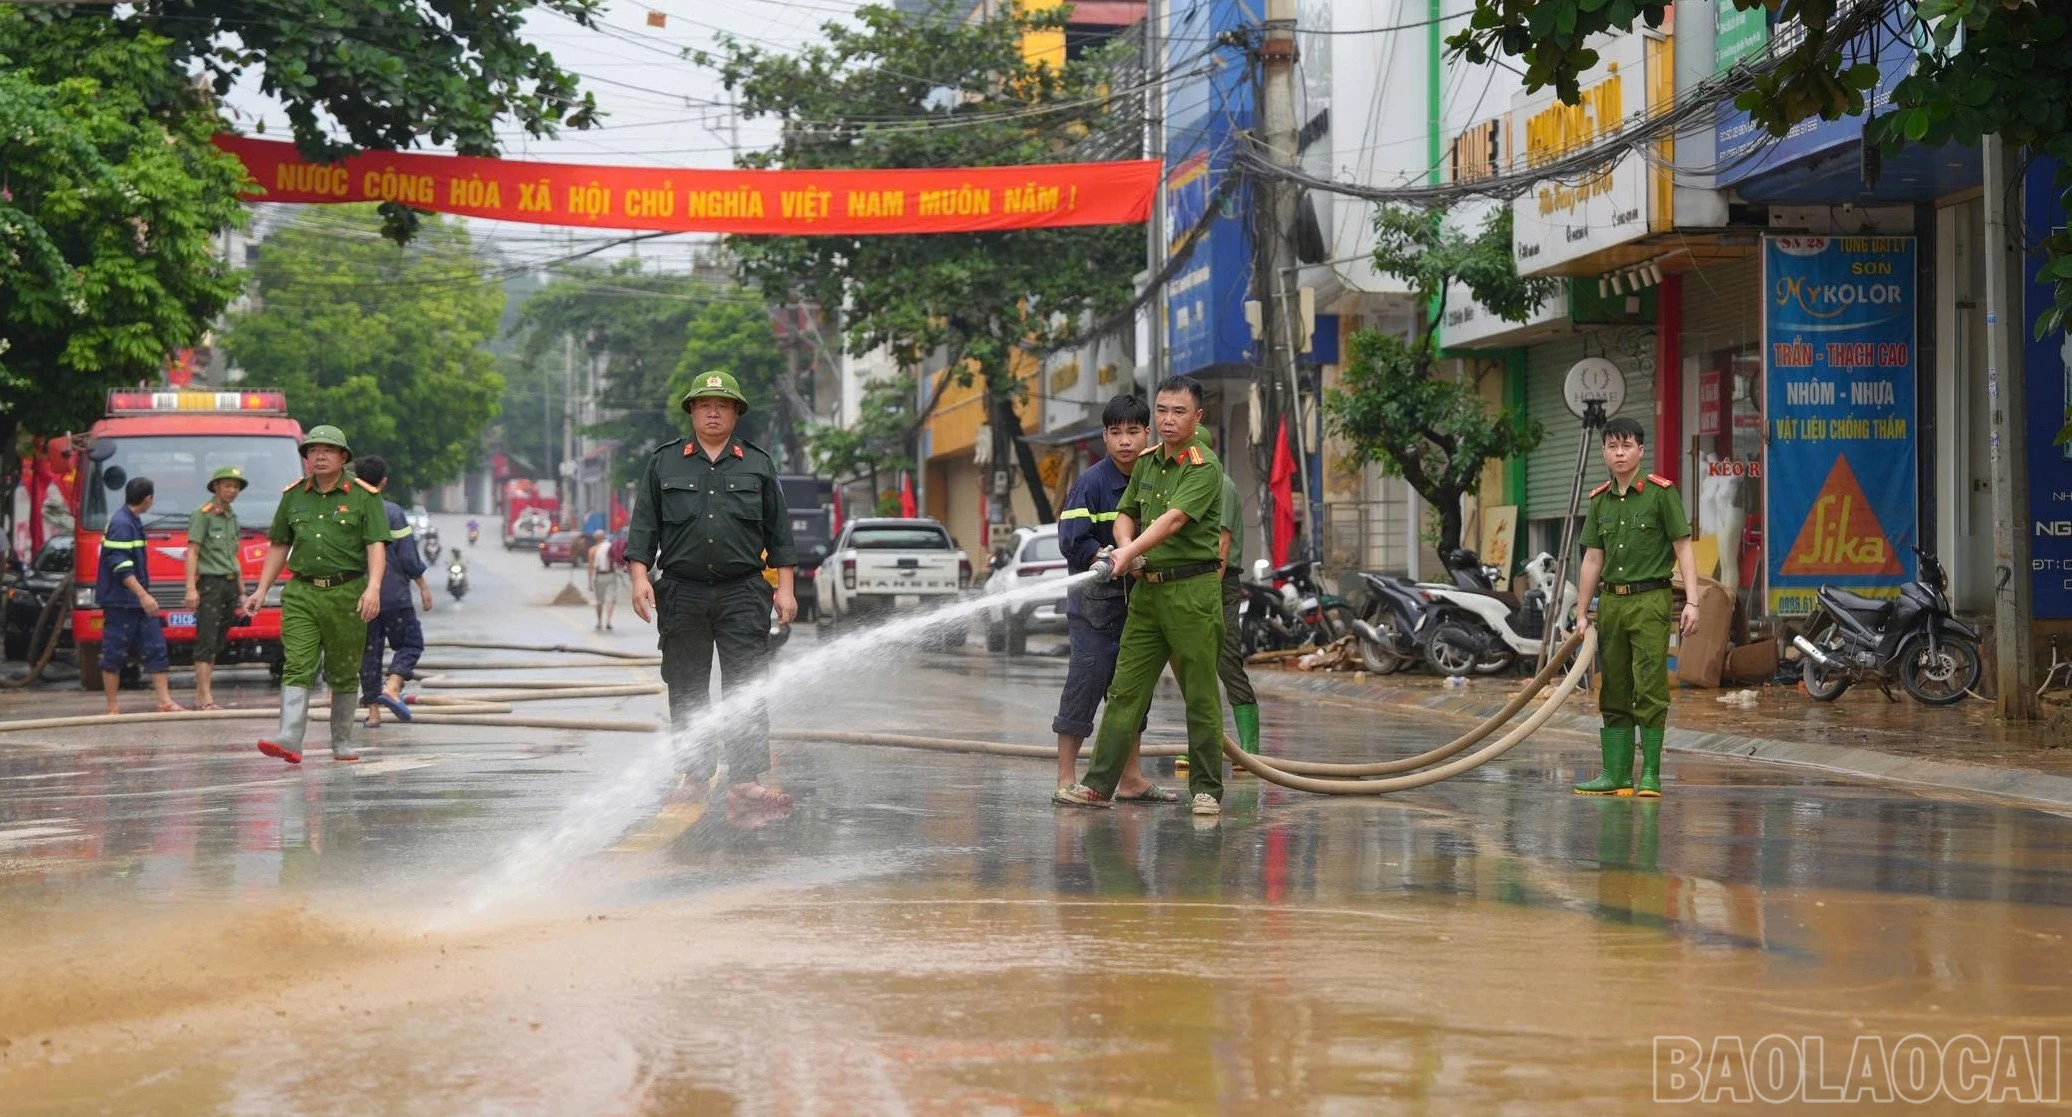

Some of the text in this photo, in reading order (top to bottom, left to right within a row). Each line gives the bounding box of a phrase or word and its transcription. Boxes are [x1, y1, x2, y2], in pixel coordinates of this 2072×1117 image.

[364, 167, 434, 204] CỘNG
[450, 174, 500, 208] HÒA
[518, 179, 552, 212] XÃ
[569, 185, 610, 221] HỘI
[625, 181, 674, 217] CHỦ
[688, 184, 764, 218] NGHĨA
[780, 184, 832, 223] VIỆT
[847, 189, 904, 218] NAM
[919, 183, 991, 216] MUÔN
[1003, 182, 1059, 213] NĂM
[1851, 260, 1892, 275] SƠN
[1825, 342, 1875, 373] THẠCH
[1877, 342, 1908, 368] CAO
[1574, 391, 1619, 403] HOME
[1785, 377, 1836, 406] NHÔM
[1850, 379, 1896, 411] NHỰA
[1776, 411, 1907, 444] VẬT LIỆU CHỐNG THẤM
[1797, 493, 1888, 565] Sika
[858, 579, 957, 588] RANGER
